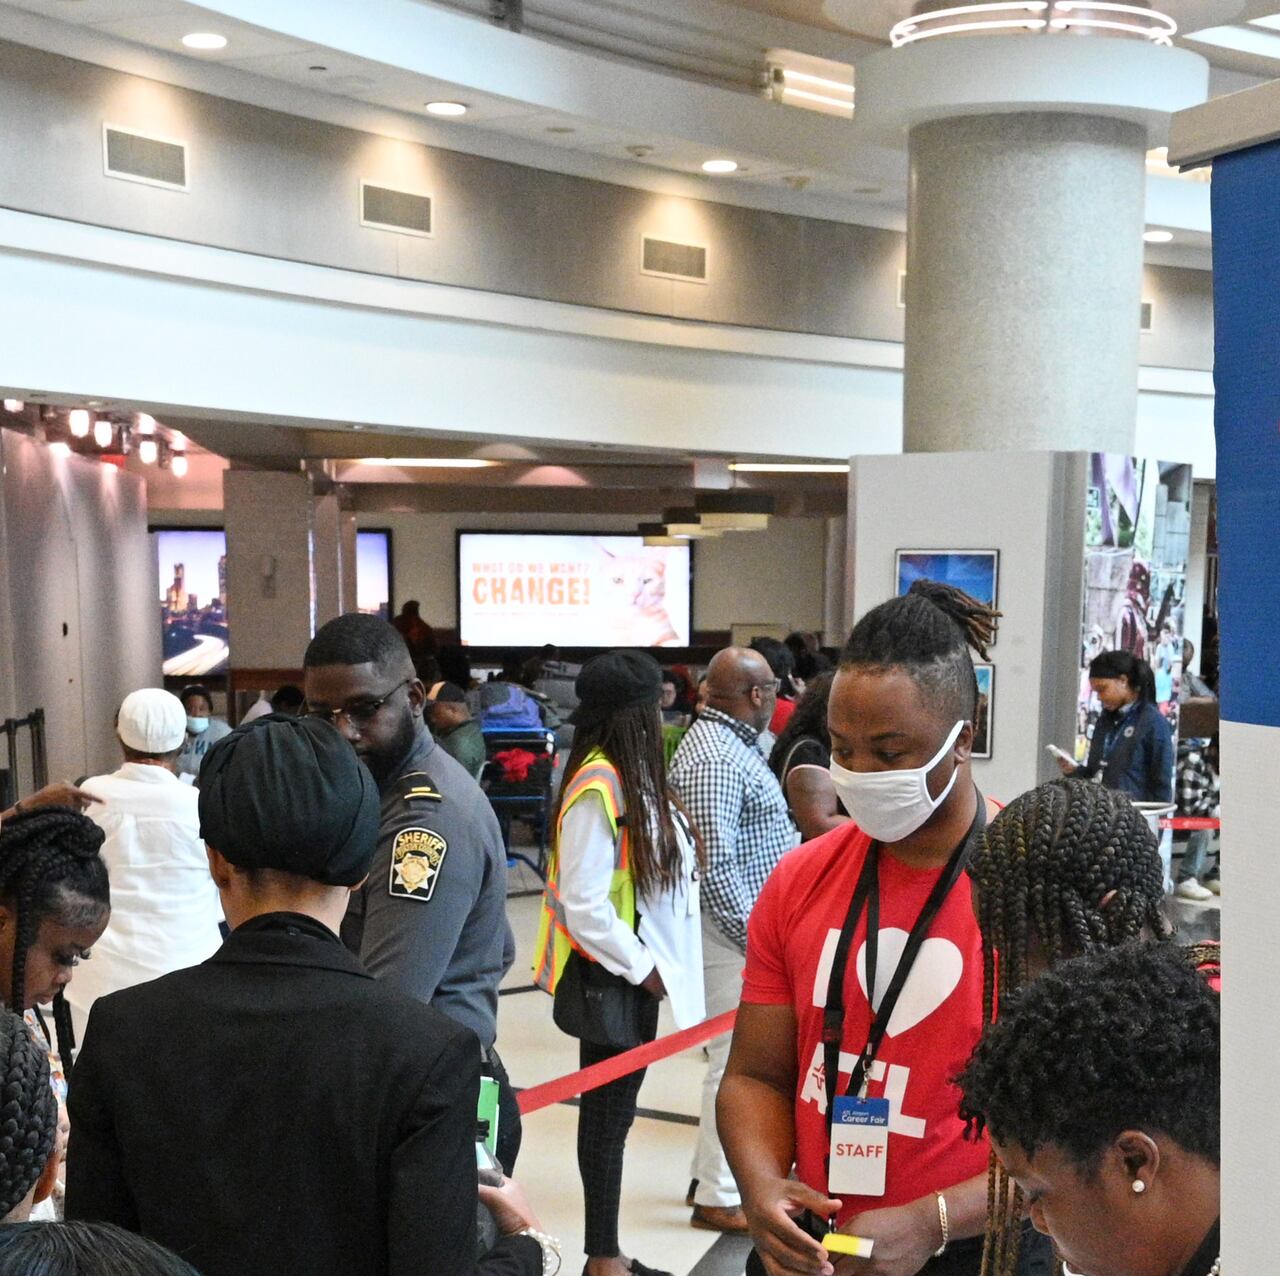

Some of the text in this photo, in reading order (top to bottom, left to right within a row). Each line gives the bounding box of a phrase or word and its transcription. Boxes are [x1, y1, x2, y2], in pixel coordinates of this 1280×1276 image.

[472, 577, 591, 605] CHANGE!
[398, 831, 445, 850] SHERIFF
[841, 1115, 885, 1124] Career Fair
[836, 1143, 884, 1158] STAFF
